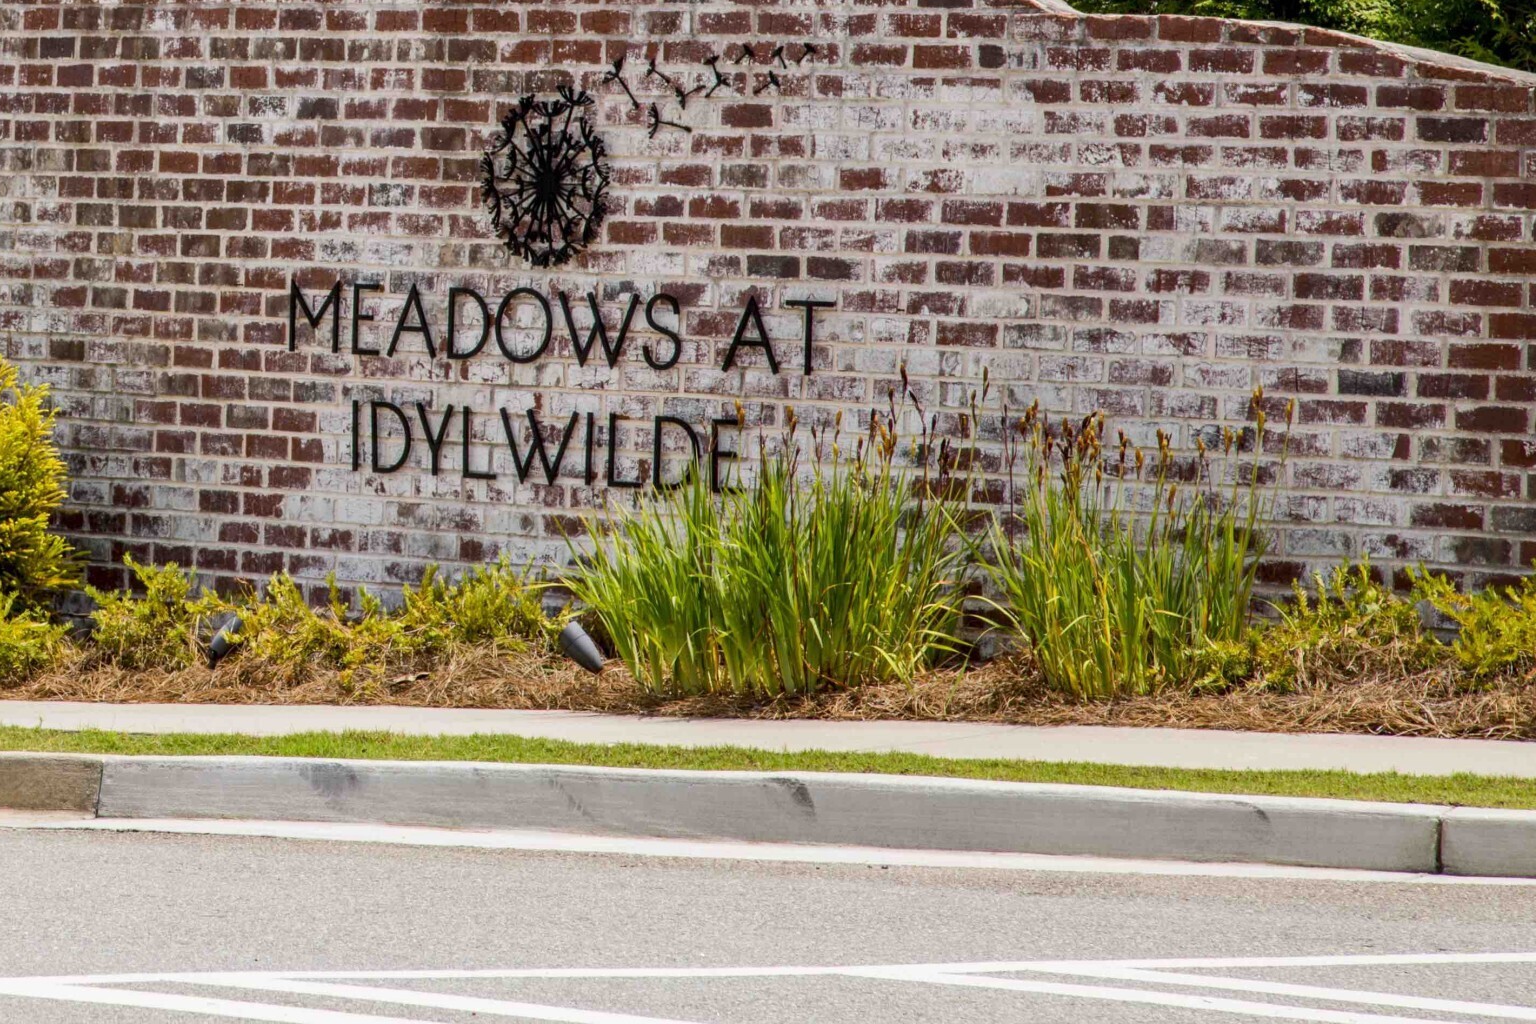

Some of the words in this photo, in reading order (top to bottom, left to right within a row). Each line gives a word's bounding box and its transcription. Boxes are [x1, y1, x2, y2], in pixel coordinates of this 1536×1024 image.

[288, 279, 682, 371] MEADOWS
[721, 295, 837, 376] AT
[351, 400, 742, 493] IDYLWILDE
